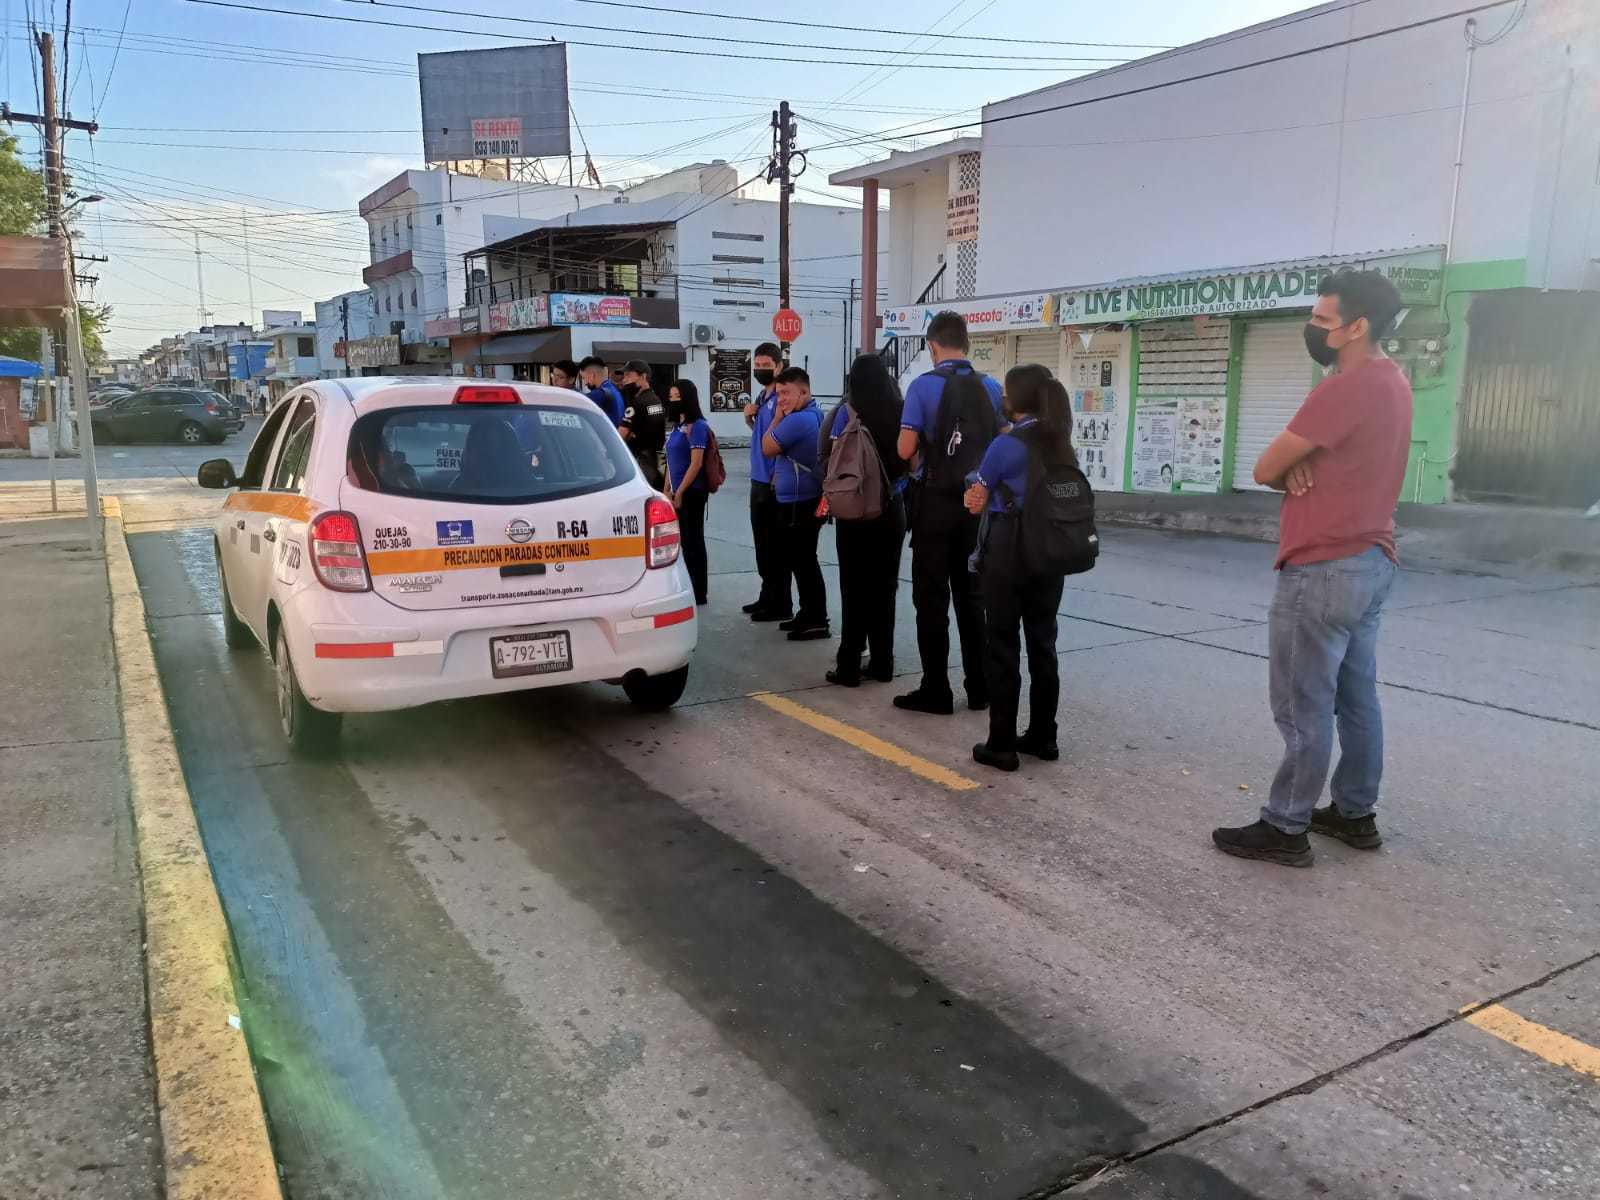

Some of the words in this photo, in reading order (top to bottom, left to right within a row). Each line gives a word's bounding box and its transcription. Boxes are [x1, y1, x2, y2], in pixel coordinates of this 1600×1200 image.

[501, 140, 510, 154] 00
[511, 140, 519, 154] 31
[1084, 290, 1121, 315] LIVE
[1126, 279, 1237, 310] NUTRITION
[1141, 304, 1207, 318] DISTRIBUIDOR
[1208, 298, 1278, 312] AUTORIZADO
[775, 318, 801, 332] ALTO
[375, 526, 408, 539] QUEJAS
[557, 520, 588, 539] R-64
[373, 537, 412, 550] 210-30-90
[444, 545, 502, 566] PRECAUCION
[504, 544, 543, 561] PARADAS
[545, 542, 590, 559] CONTINUAS
[496, 641, 567, 665] A-792-VTE
